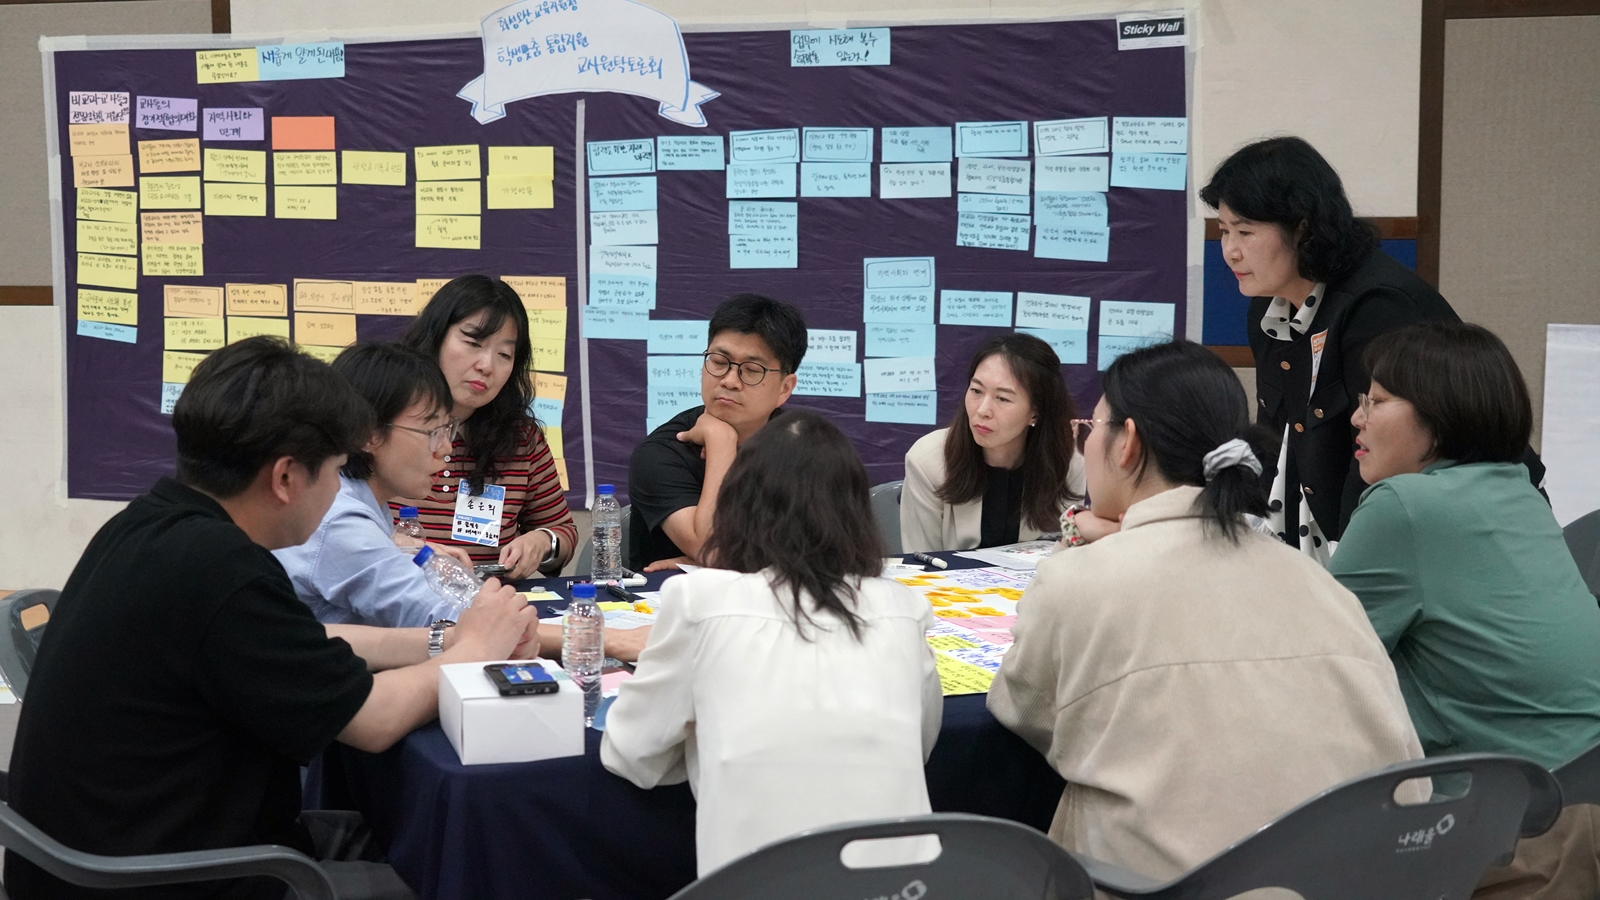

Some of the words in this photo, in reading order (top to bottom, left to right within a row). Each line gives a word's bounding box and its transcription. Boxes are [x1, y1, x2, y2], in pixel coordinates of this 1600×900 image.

[1123, 24, 1155, 35] Sticky
[1157, 22, 1180, 32] Wall
[546, 32, 589, 54] 통합지원
[262, 49, 292, 67] 새롭게
[577, 56, 662, 79] 교사원탁토론회
[207, 111, 252, 122] 지역사회와
[219, 127, 241, 137] 연계
